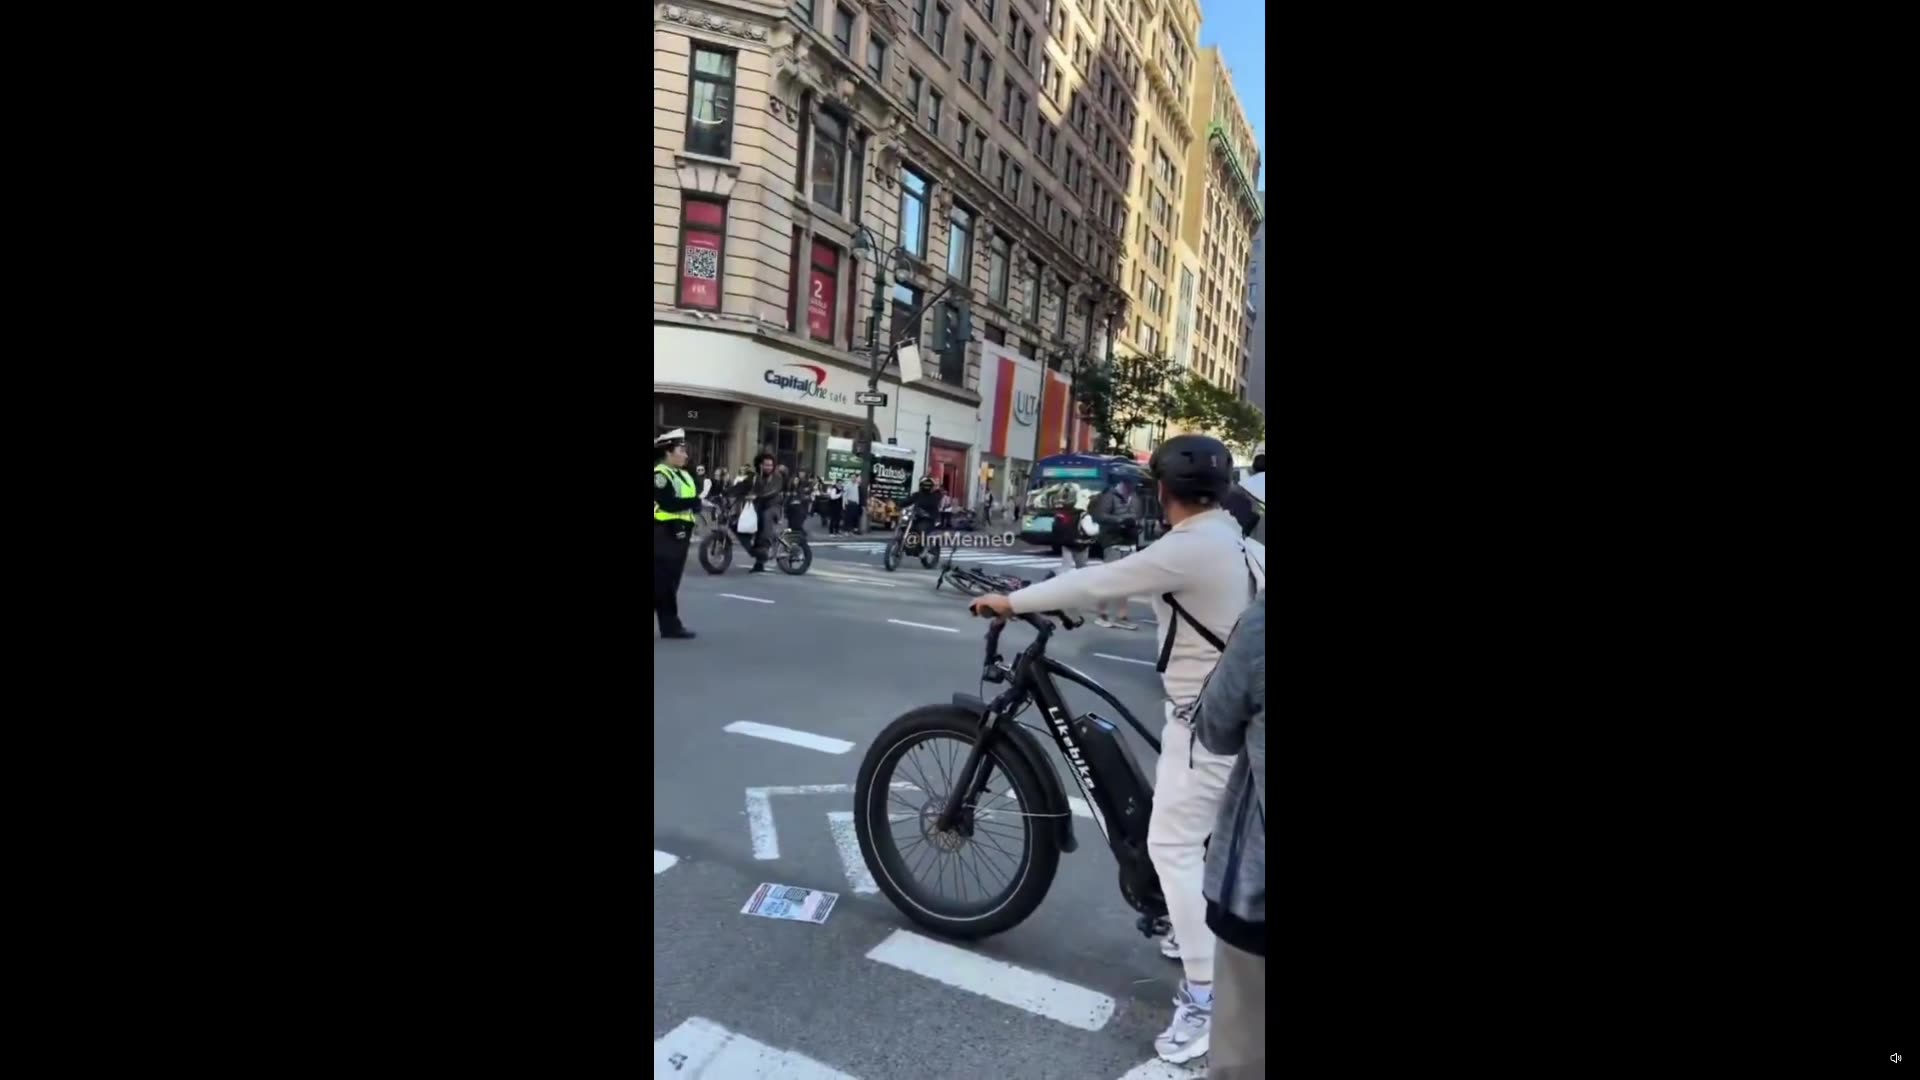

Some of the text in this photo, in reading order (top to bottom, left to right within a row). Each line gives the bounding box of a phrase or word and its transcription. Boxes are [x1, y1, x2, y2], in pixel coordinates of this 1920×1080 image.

[764, 370, 809, 390] Capital
[808, 381, 828, 399] One
[1048, 706, 1095, 790] Likebike
